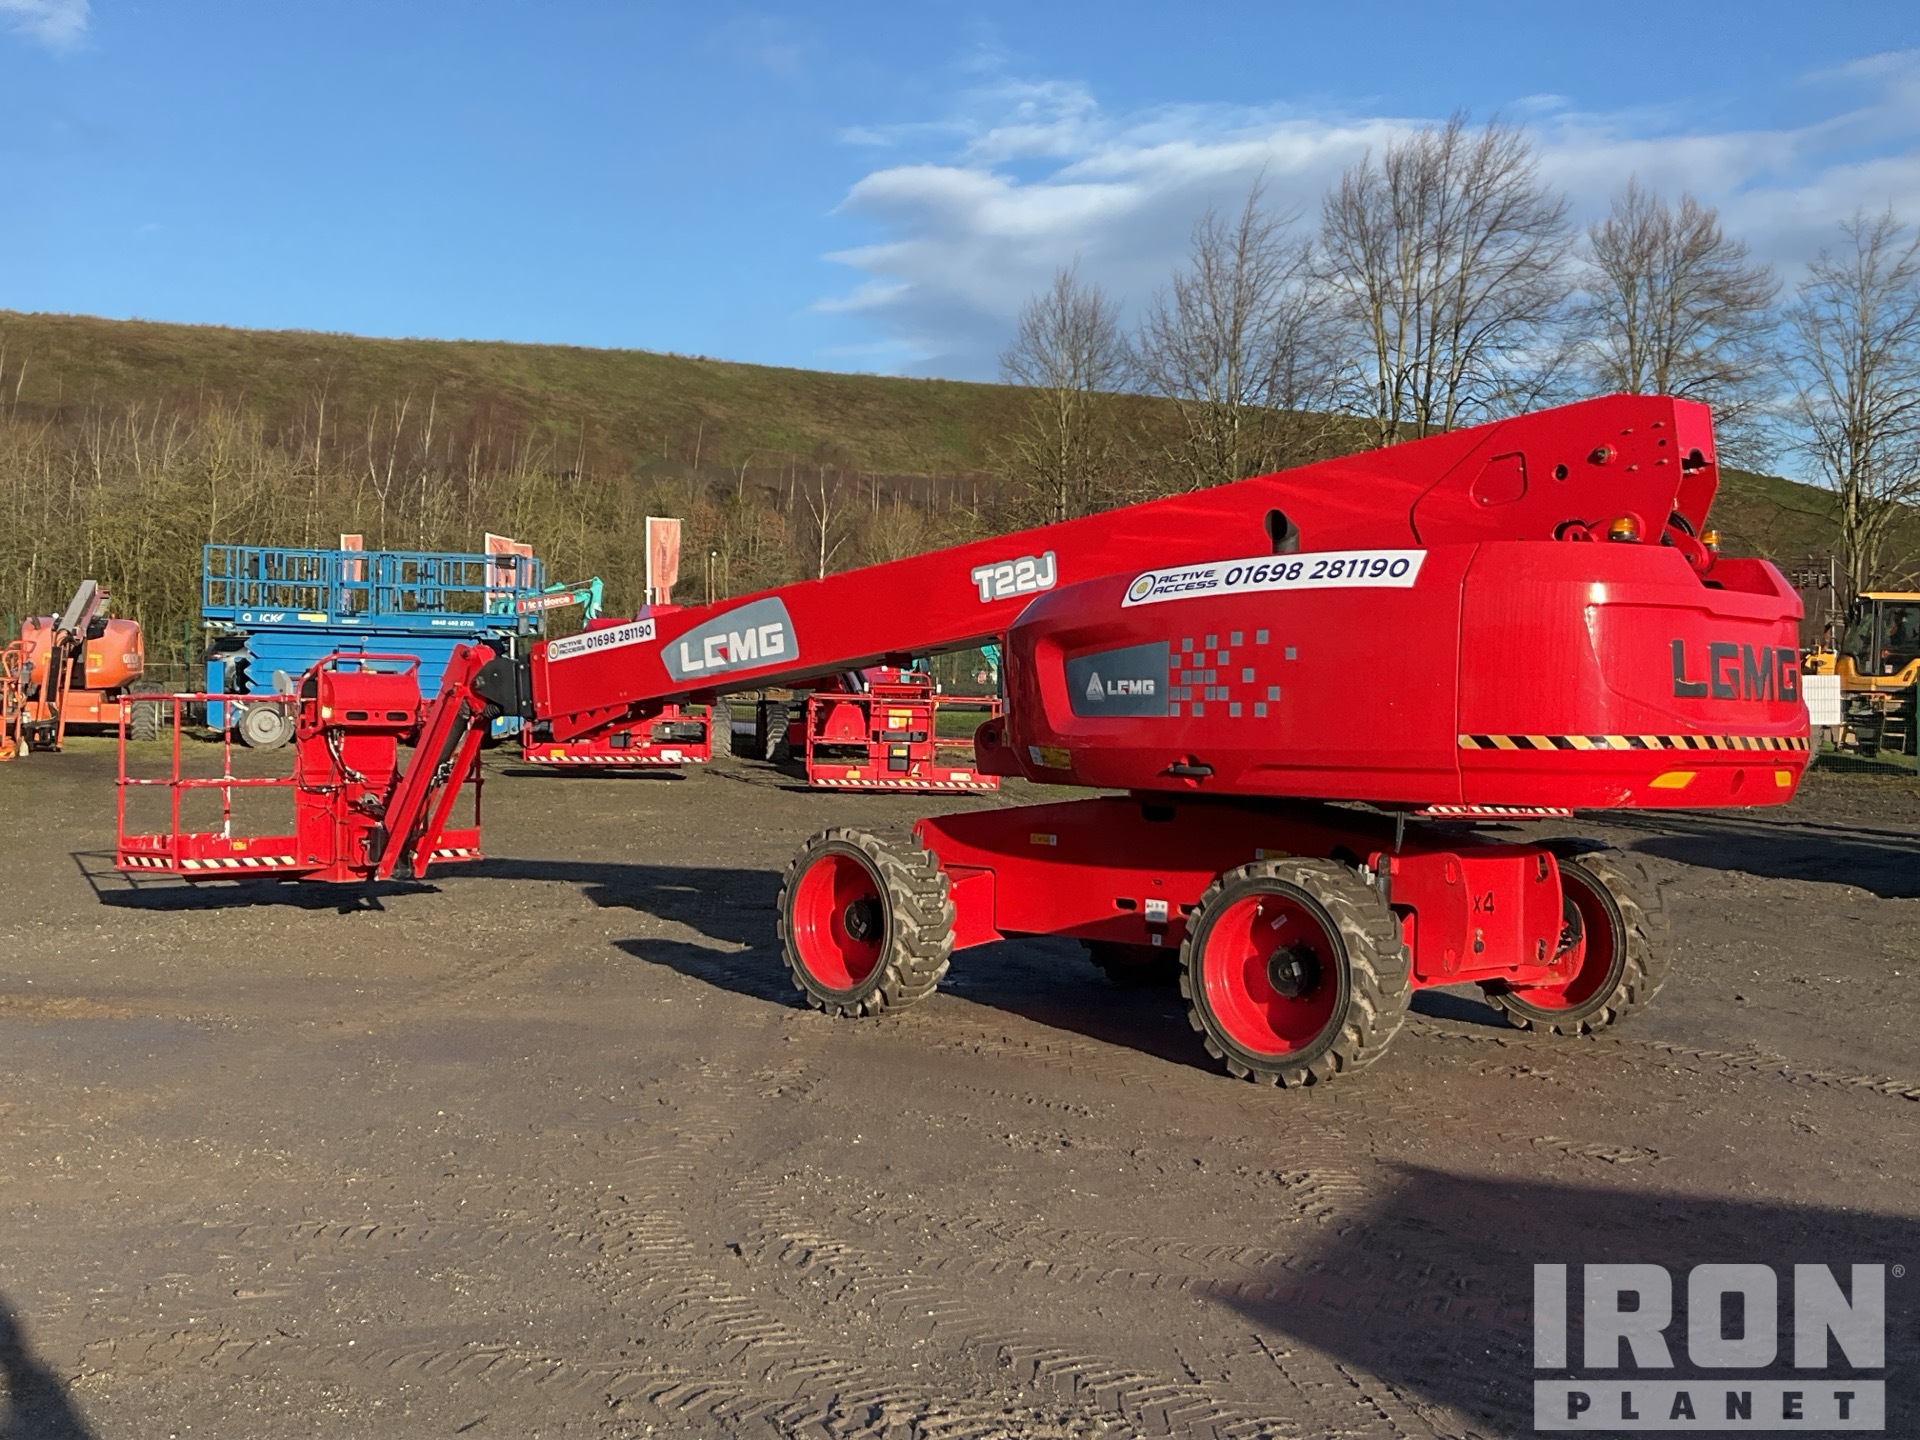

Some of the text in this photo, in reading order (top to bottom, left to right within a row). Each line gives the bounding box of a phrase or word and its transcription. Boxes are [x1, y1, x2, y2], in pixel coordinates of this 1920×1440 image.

[974, 556, 1054, 598] T22J
[1158, 569, 1216, 584] ACTIVE
[1224, 558, 1410, 586] 01698 281190
[1153, 579, 1219, 595] ACCESS
[559, 639, 582, 650] ACTIVE
[586, 624, 652, 649] 01698 281190
[559, 645, 586, 655] ACCESS
[680, 622, 785, 673] LGMG
[1671, 639, 1798, 702] LGMG
[1107, 679, 1155, 696] LGMG
